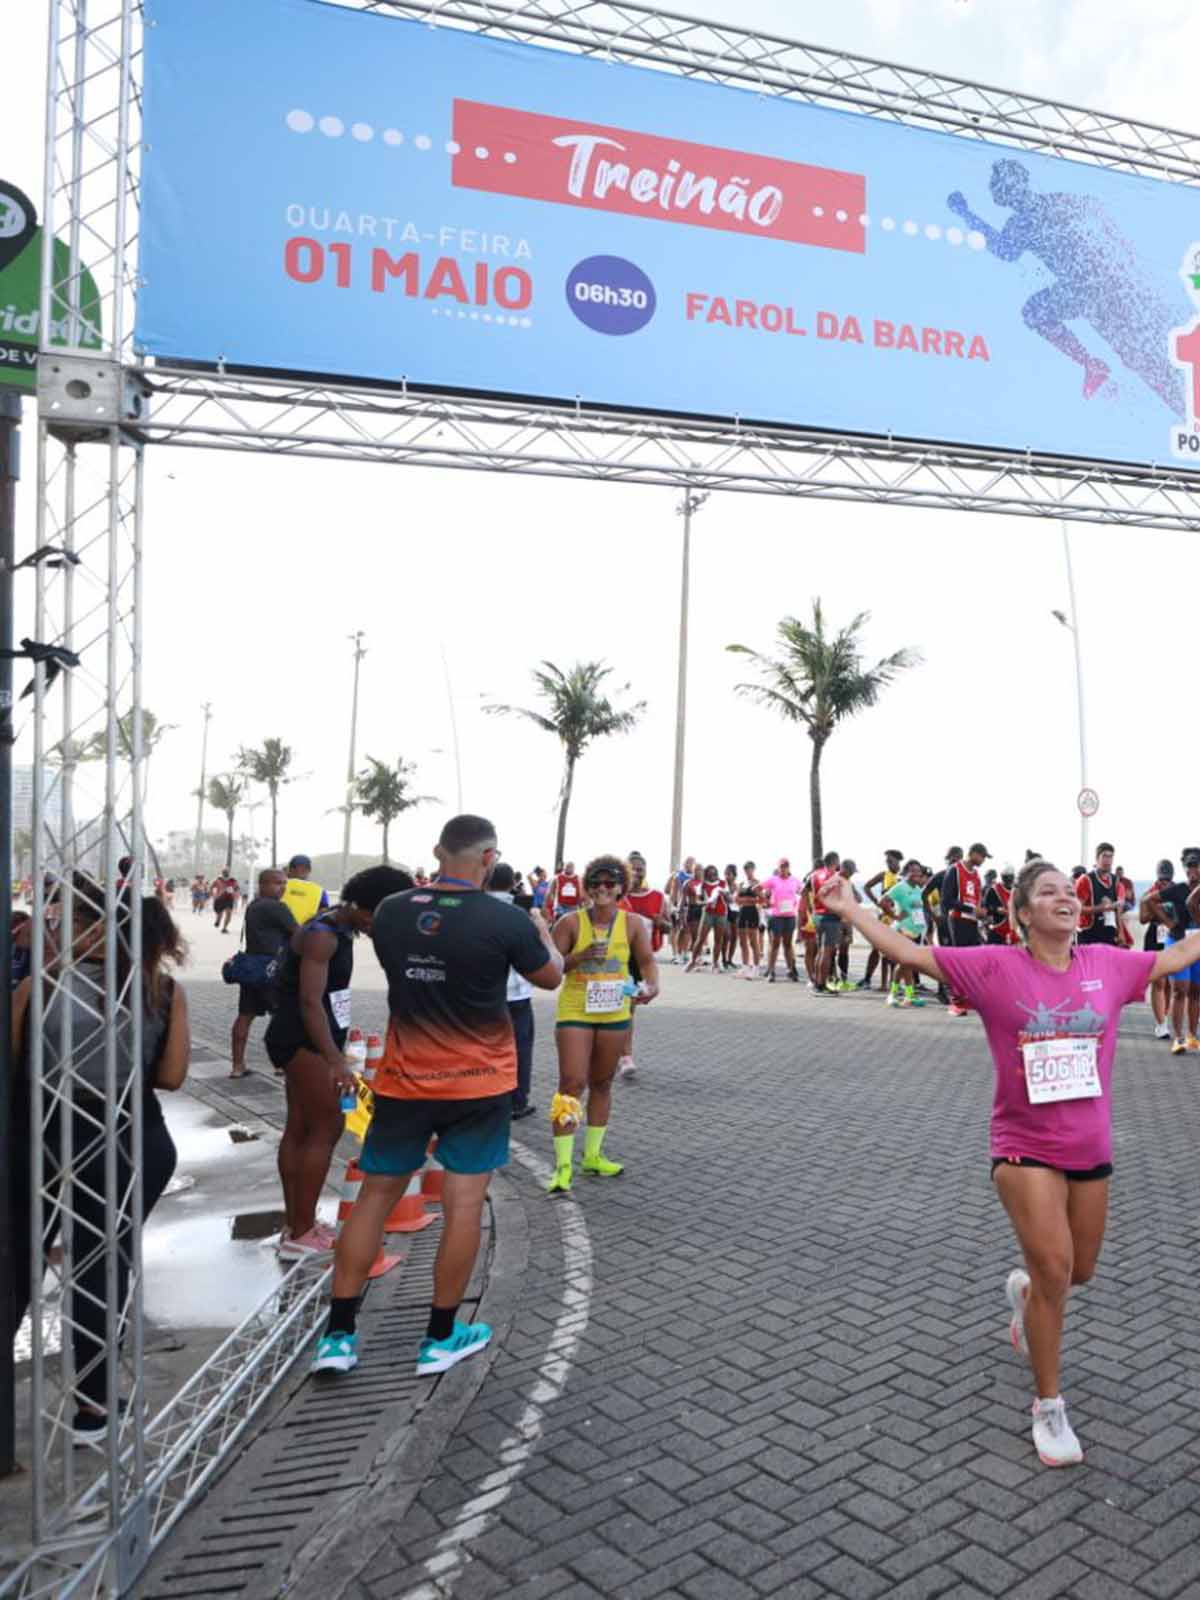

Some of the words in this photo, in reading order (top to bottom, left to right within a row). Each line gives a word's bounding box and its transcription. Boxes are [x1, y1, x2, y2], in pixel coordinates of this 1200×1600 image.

[553, 133, 784, 227] Treinão
[285, 203, 533, 261] QUARTA-FEIRA
[283, 236, 353, 286] 01
[372, 250, 533, 311] MAIO
[574, 281, 648, 311] 06h30
[686, 292, 806, 337] FAROL
[816, 310, 864, 345] DA
[873, 318, 990, 362] BARRA
